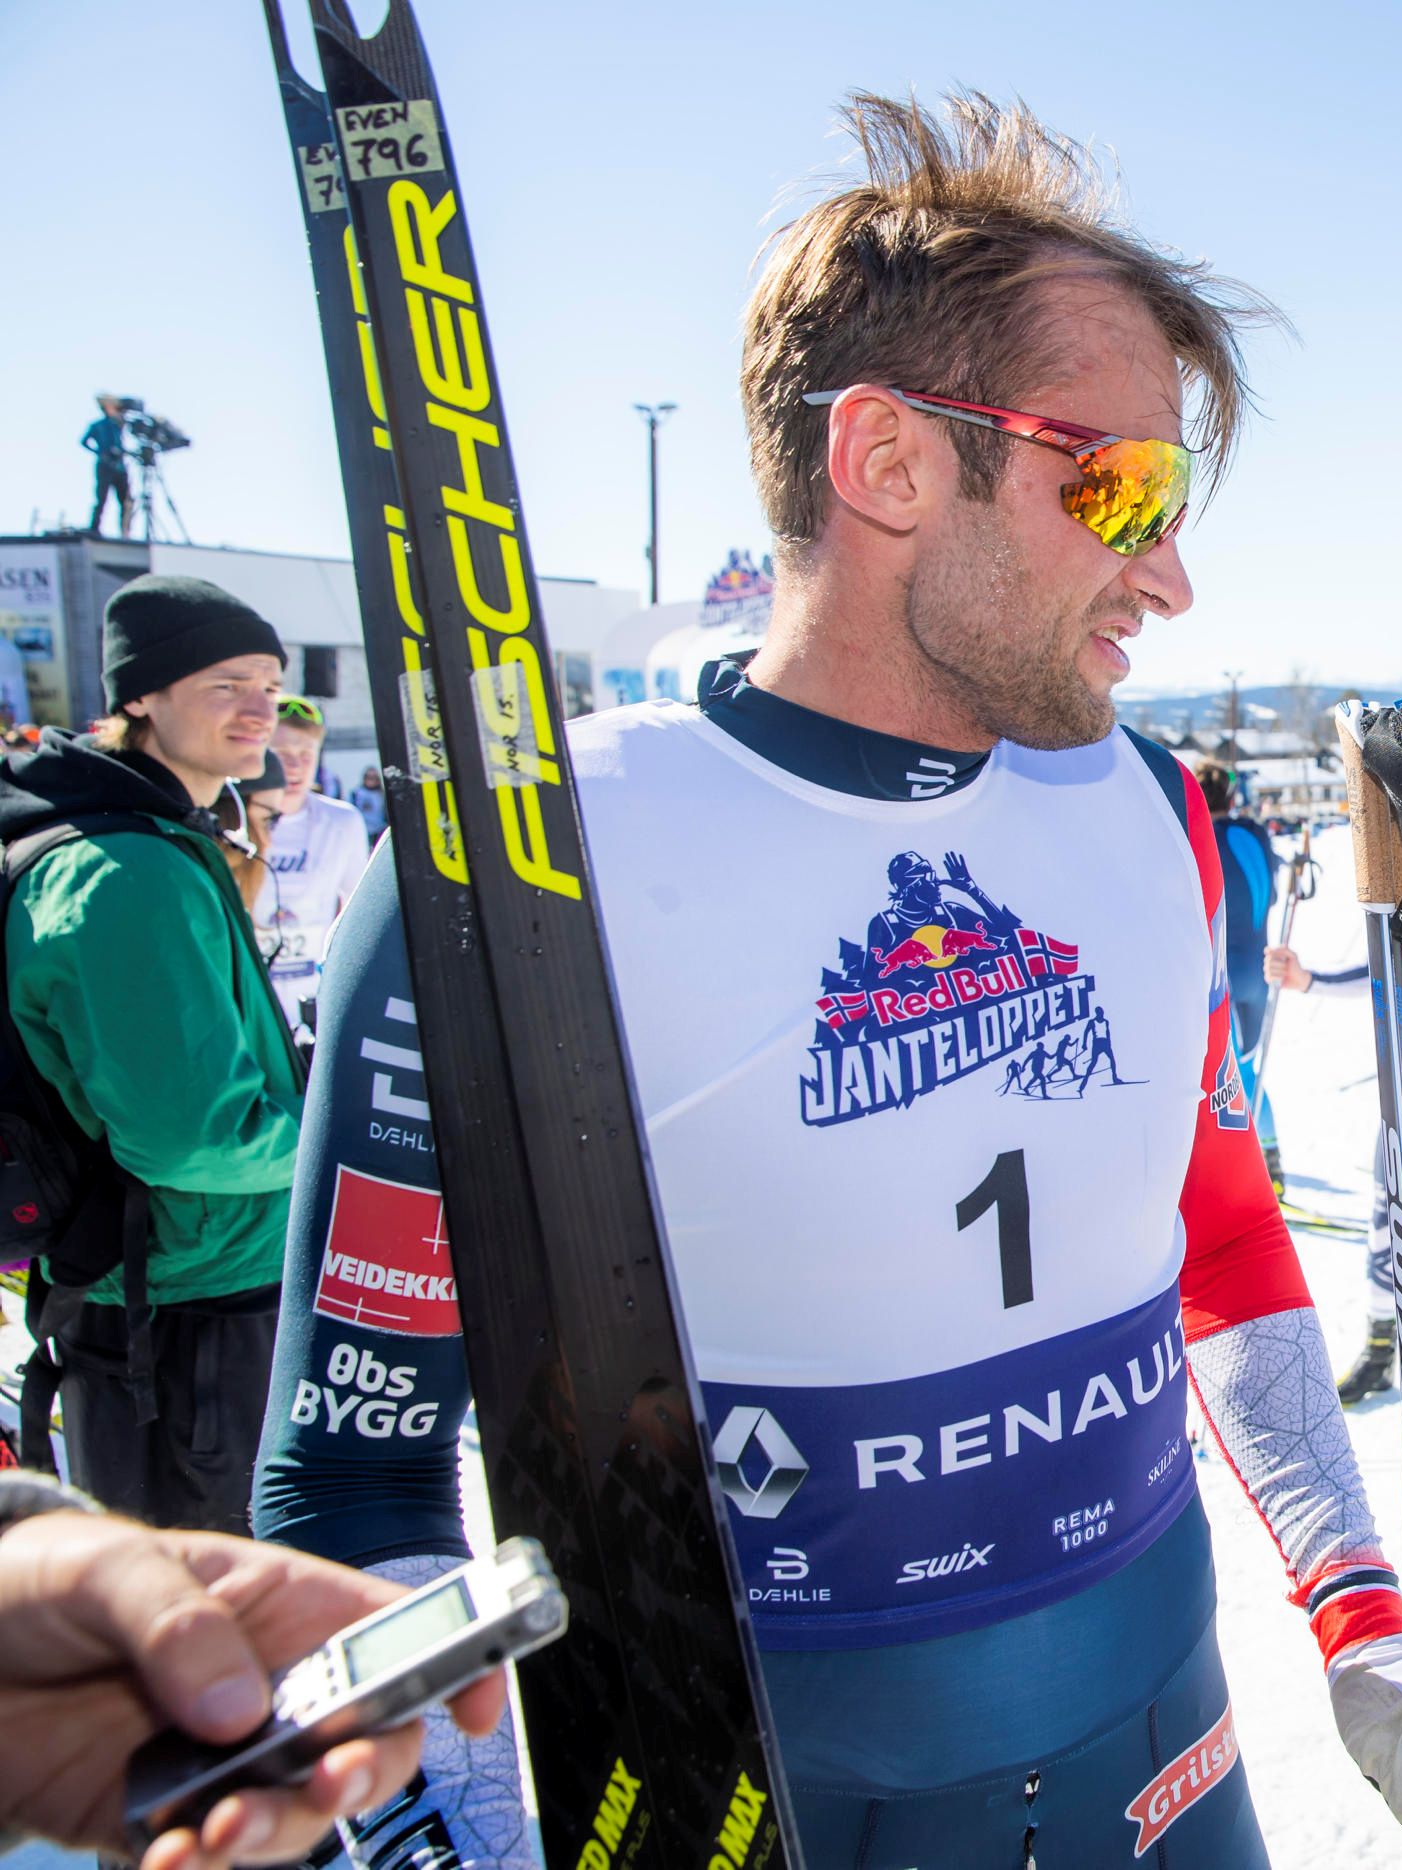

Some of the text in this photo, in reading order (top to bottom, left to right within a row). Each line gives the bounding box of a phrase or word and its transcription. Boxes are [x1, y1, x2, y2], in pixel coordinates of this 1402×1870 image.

[343, 102, 409, 132] EVEN
[305, 145, 337, 166] EV
[351, 134, 429, 177] 796
[388, 180, 582, 900] FISCHER
[872, 953, 1026, 1026] Red Bull
[803, 977, 1092, 1124] JANTELOPPET
[369, 1122, 435, 1152] DÆHL
[956, 1149, 1034, 1309] 1
[324, 1250, 458, 1301] VEIDEKK
[290, 1378, 439, 1438] BYGG
[1148, 1437, 1180, 1487] SKILINE
[1053, 1499, 1115, 1535] REMA
[1061, 1520, 1108, 1551] 1000
